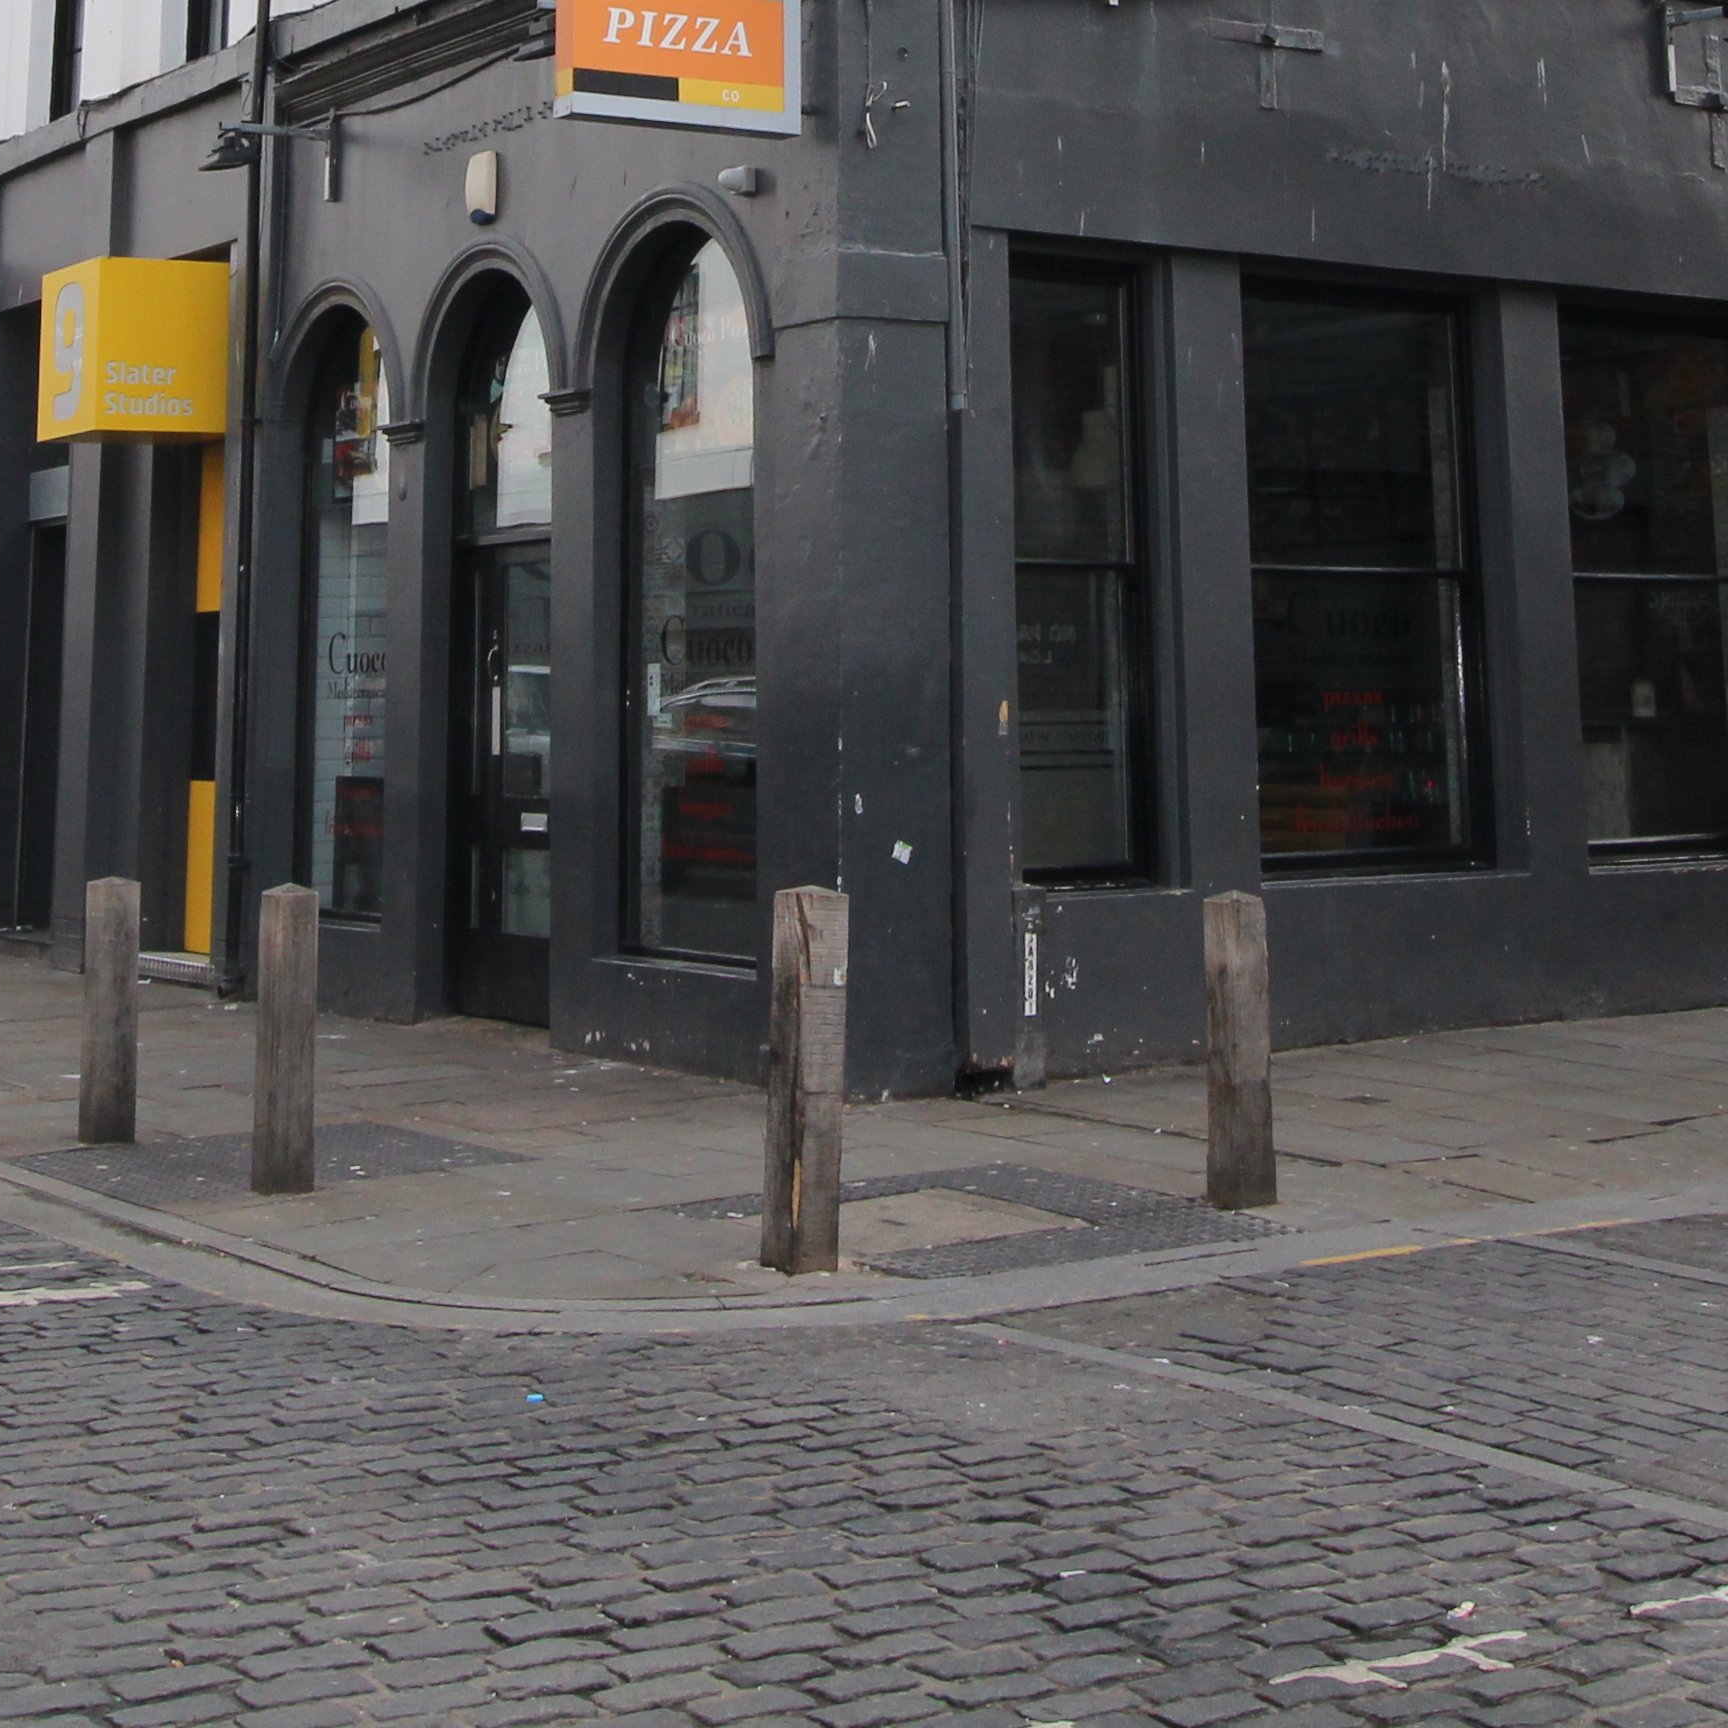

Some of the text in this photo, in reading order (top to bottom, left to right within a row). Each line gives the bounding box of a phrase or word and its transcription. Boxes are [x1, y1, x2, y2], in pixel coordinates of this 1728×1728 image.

[602, 6, 753, 58] PIZZA
[722, 89, 740, 102] CO
[53, 282, 85, 422] 9
[105, 360, 177, 385] Slater
[105, 392, 195, 417] Studios
[328, 632, 387, 676] Cuoc
